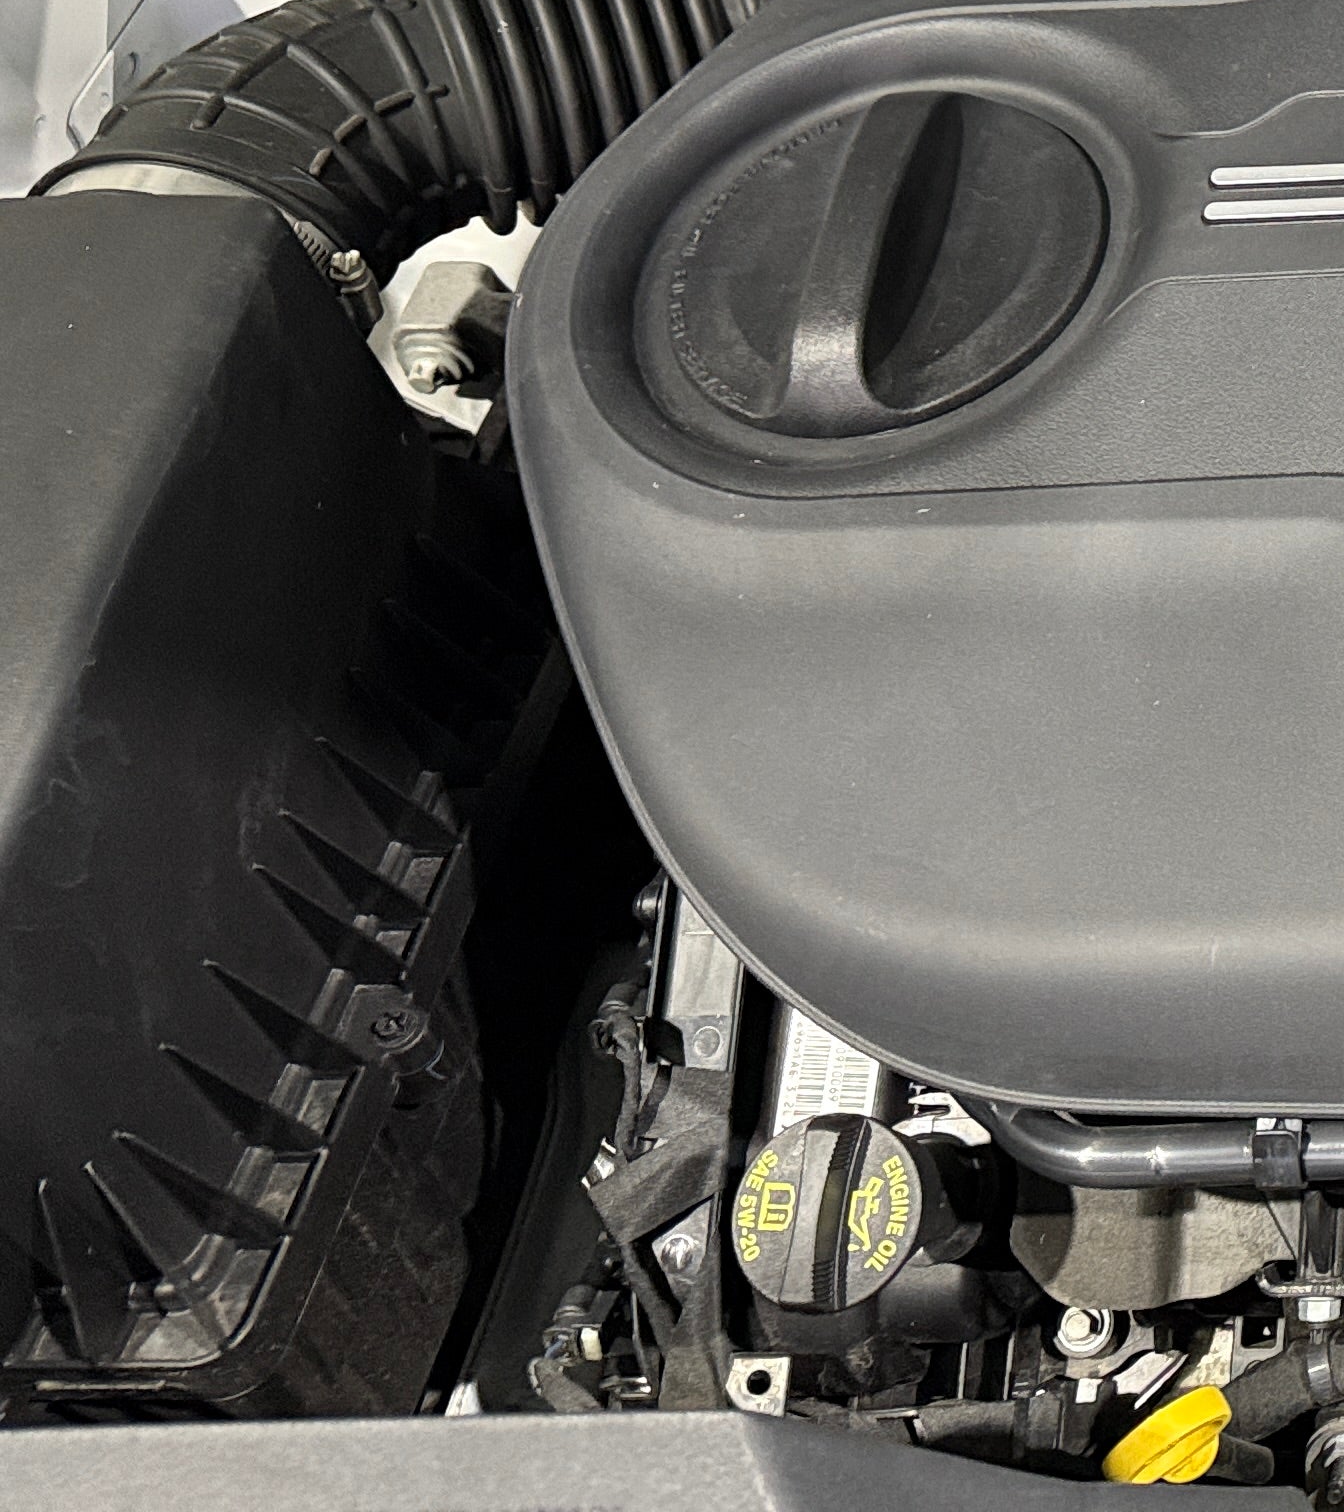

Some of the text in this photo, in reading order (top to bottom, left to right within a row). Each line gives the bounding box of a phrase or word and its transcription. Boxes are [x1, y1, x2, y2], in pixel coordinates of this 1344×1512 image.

[737, 1149, 779, 1262] SAE 5W-20
[864, 1155, 909, 1272] ENGINE OIL
